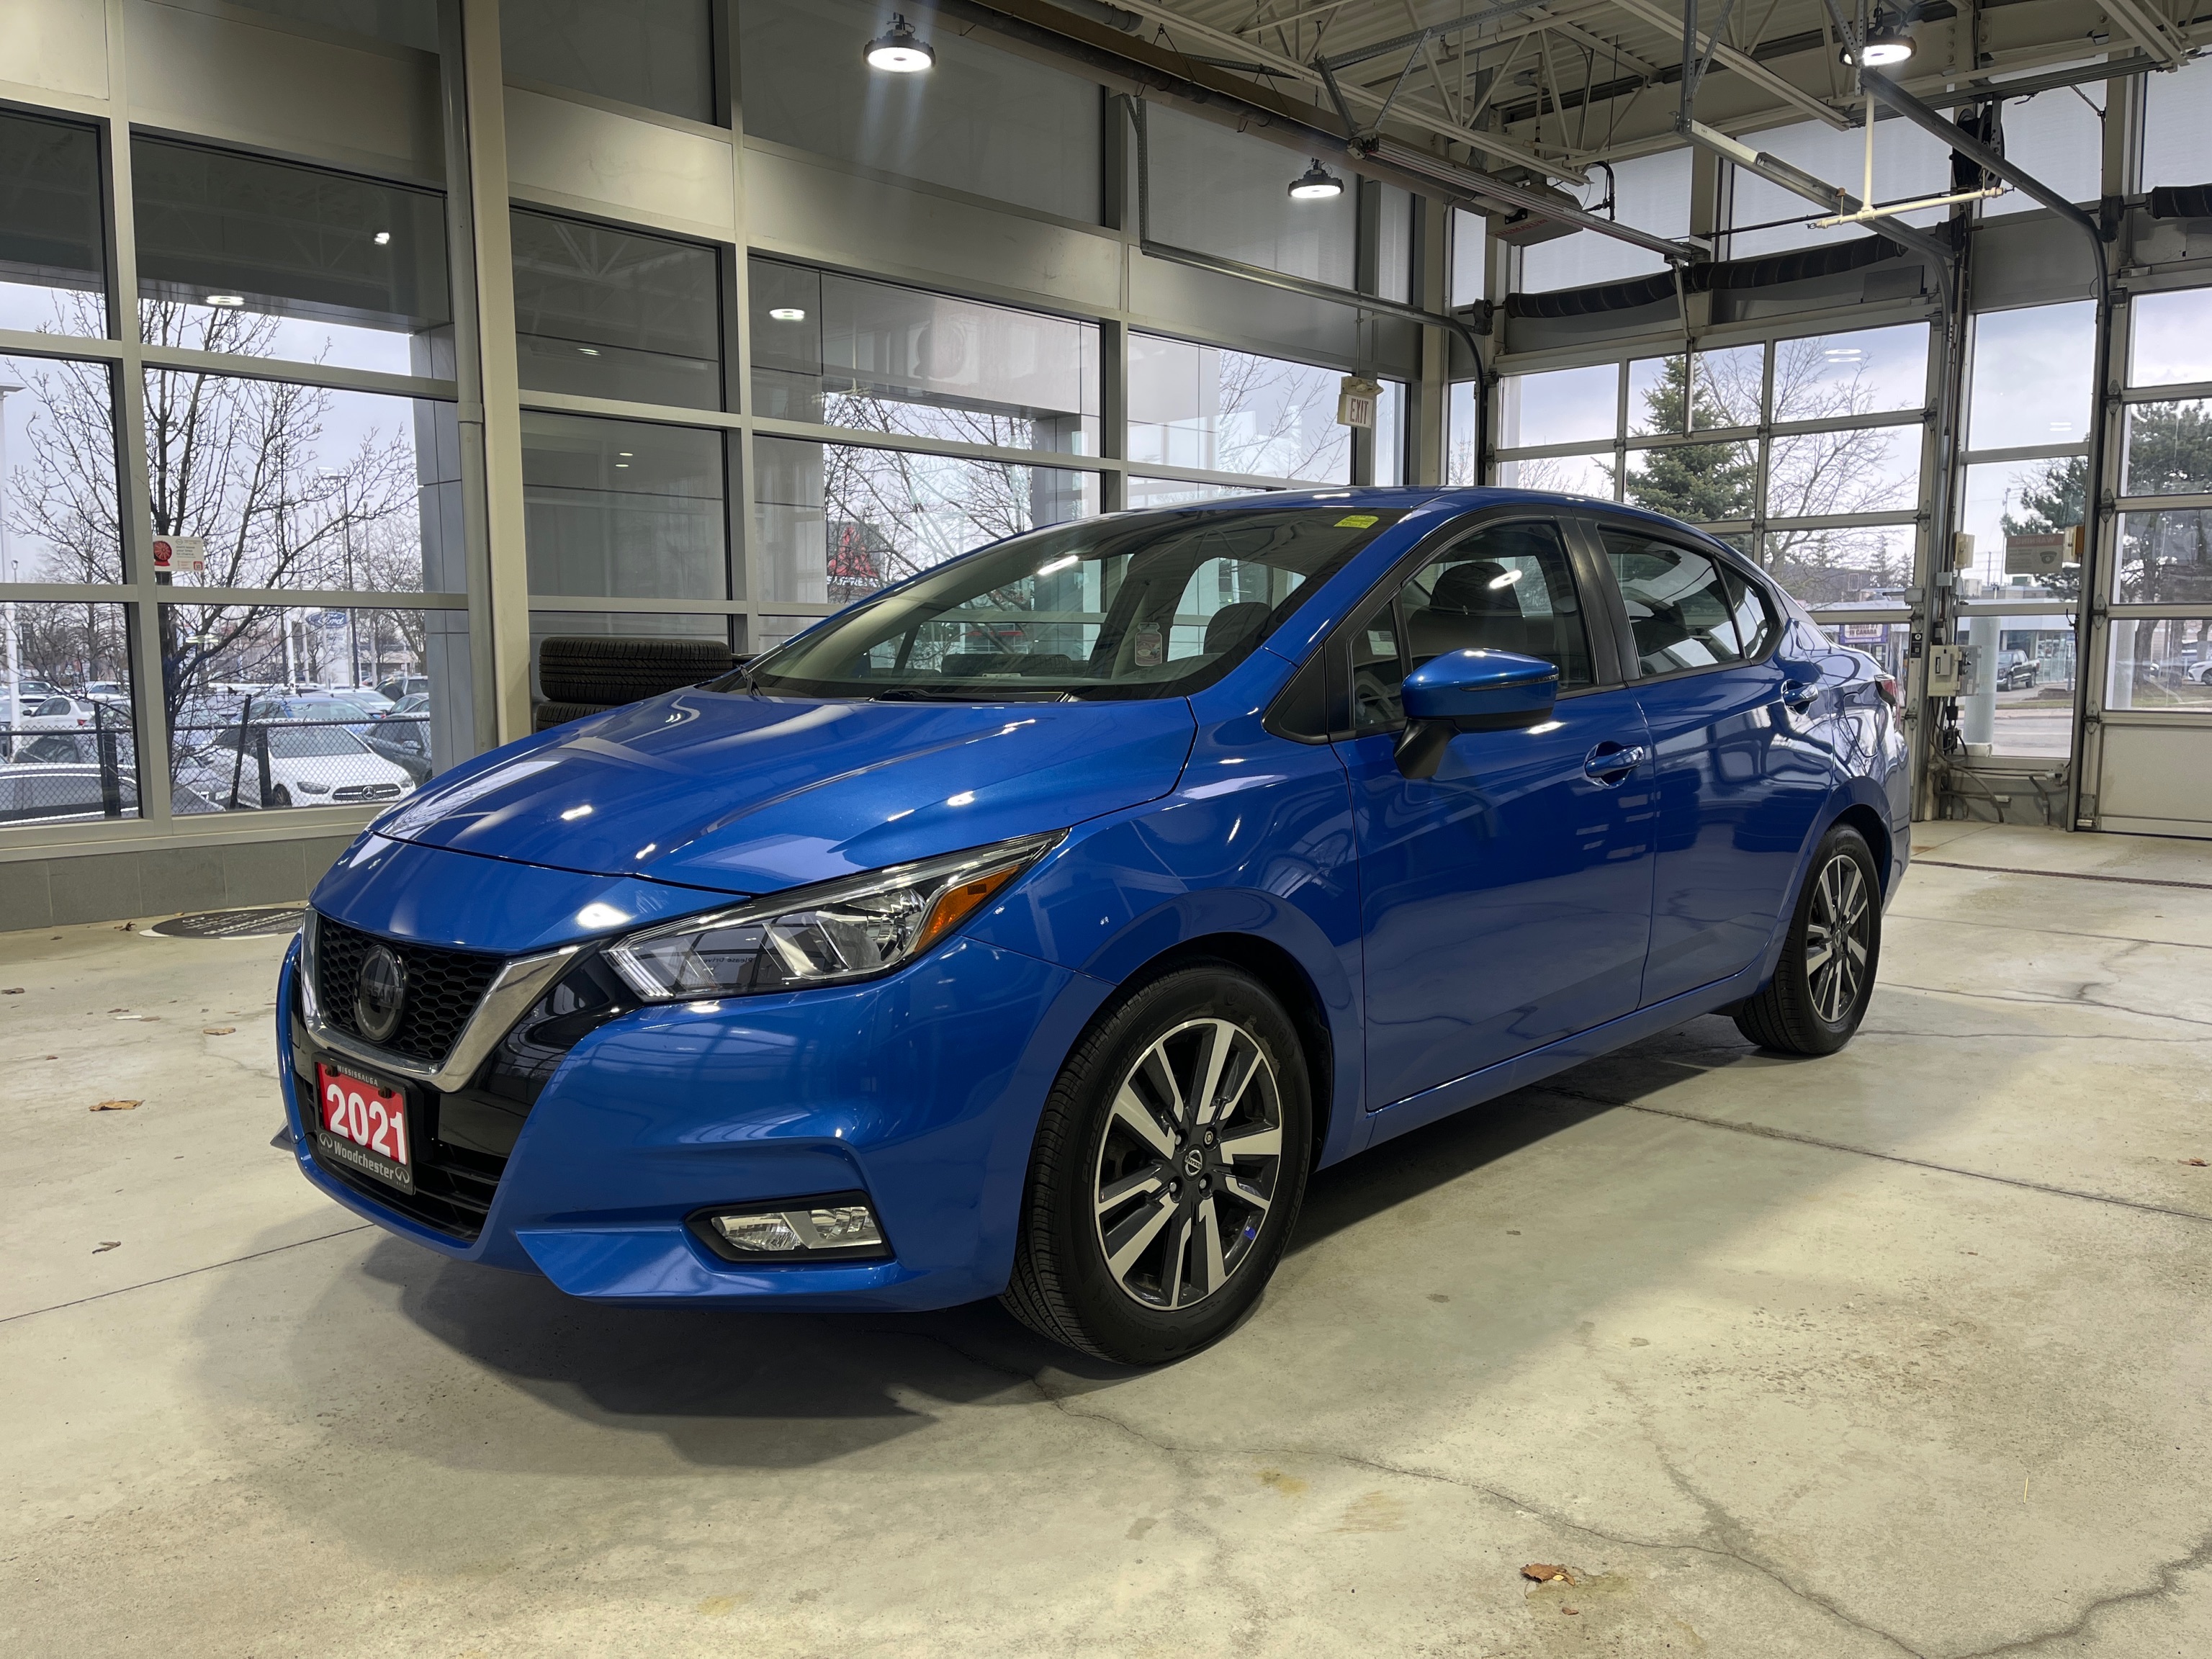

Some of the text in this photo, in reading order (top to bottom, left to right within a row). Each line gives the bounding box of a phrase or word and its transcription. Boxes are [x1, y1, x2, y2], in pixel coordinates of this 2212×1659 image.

[1350, 398, 1369, 424] EXIT
[318, 614, 343, 625] Ford
[337, 1065, 378, 1086] MISSISSAUGA
[327, 1084, 408, 1165] 2021
[334, 1141, 394, 1180] Woodchester
